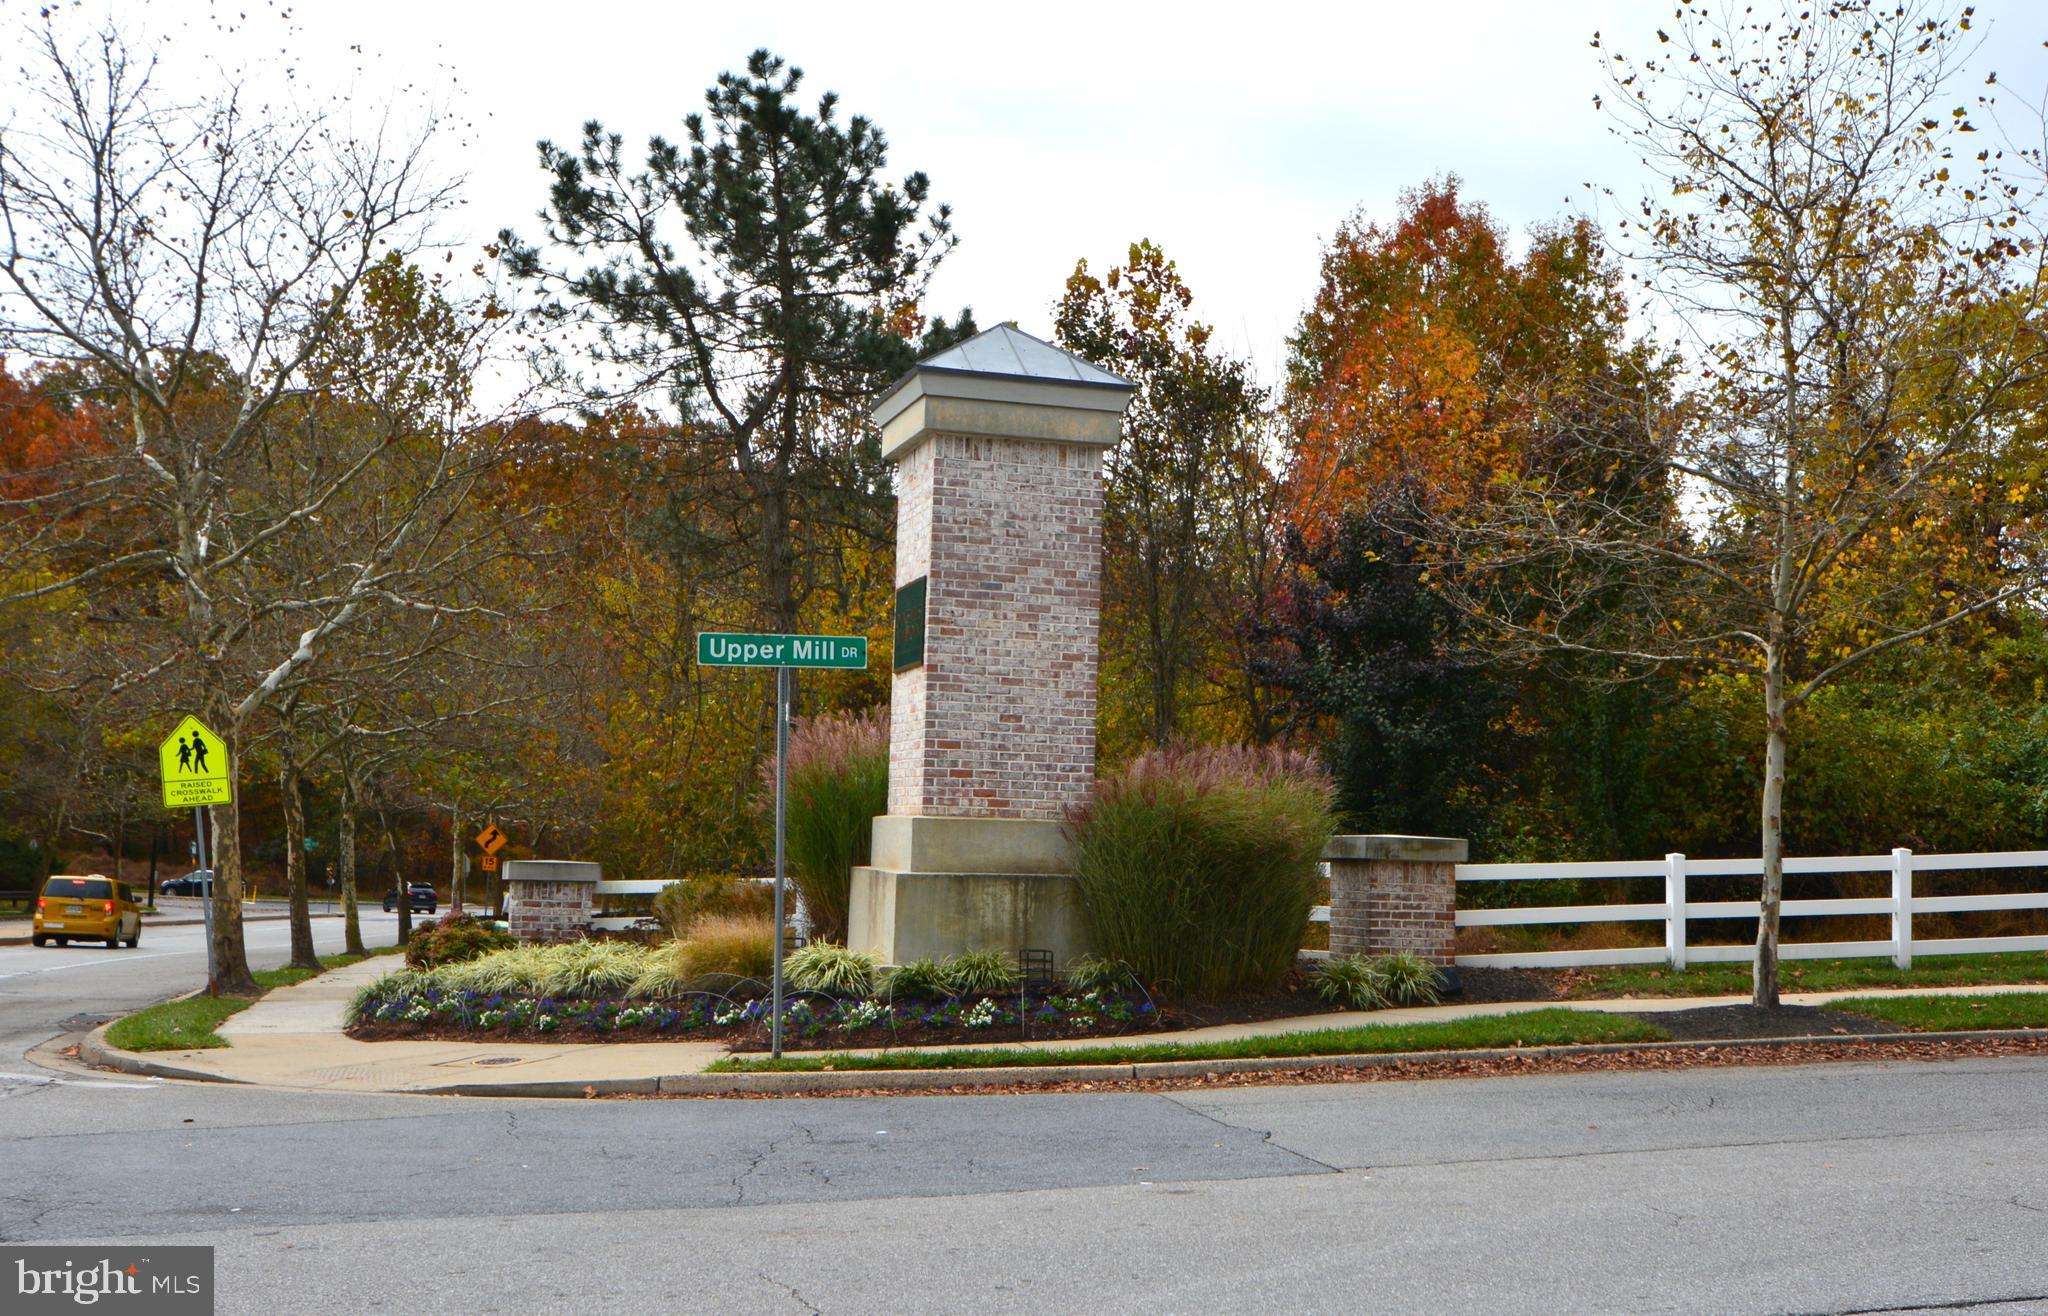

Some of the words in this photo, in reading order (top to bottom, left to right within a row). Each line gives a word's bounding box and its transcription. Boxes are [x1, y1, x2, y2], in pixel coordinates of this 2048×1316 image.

[710, 638, 784, 662] Upper
[793, 640, 835, 660] Mill
[841, 647, 858, 658] DR
[180, 781, 212, 789] RAISED
[170, 788, 223, 797] CROSSWALK
[183, 794, 214, 803] AHEAD
[485, 858, 495, 866] 15
